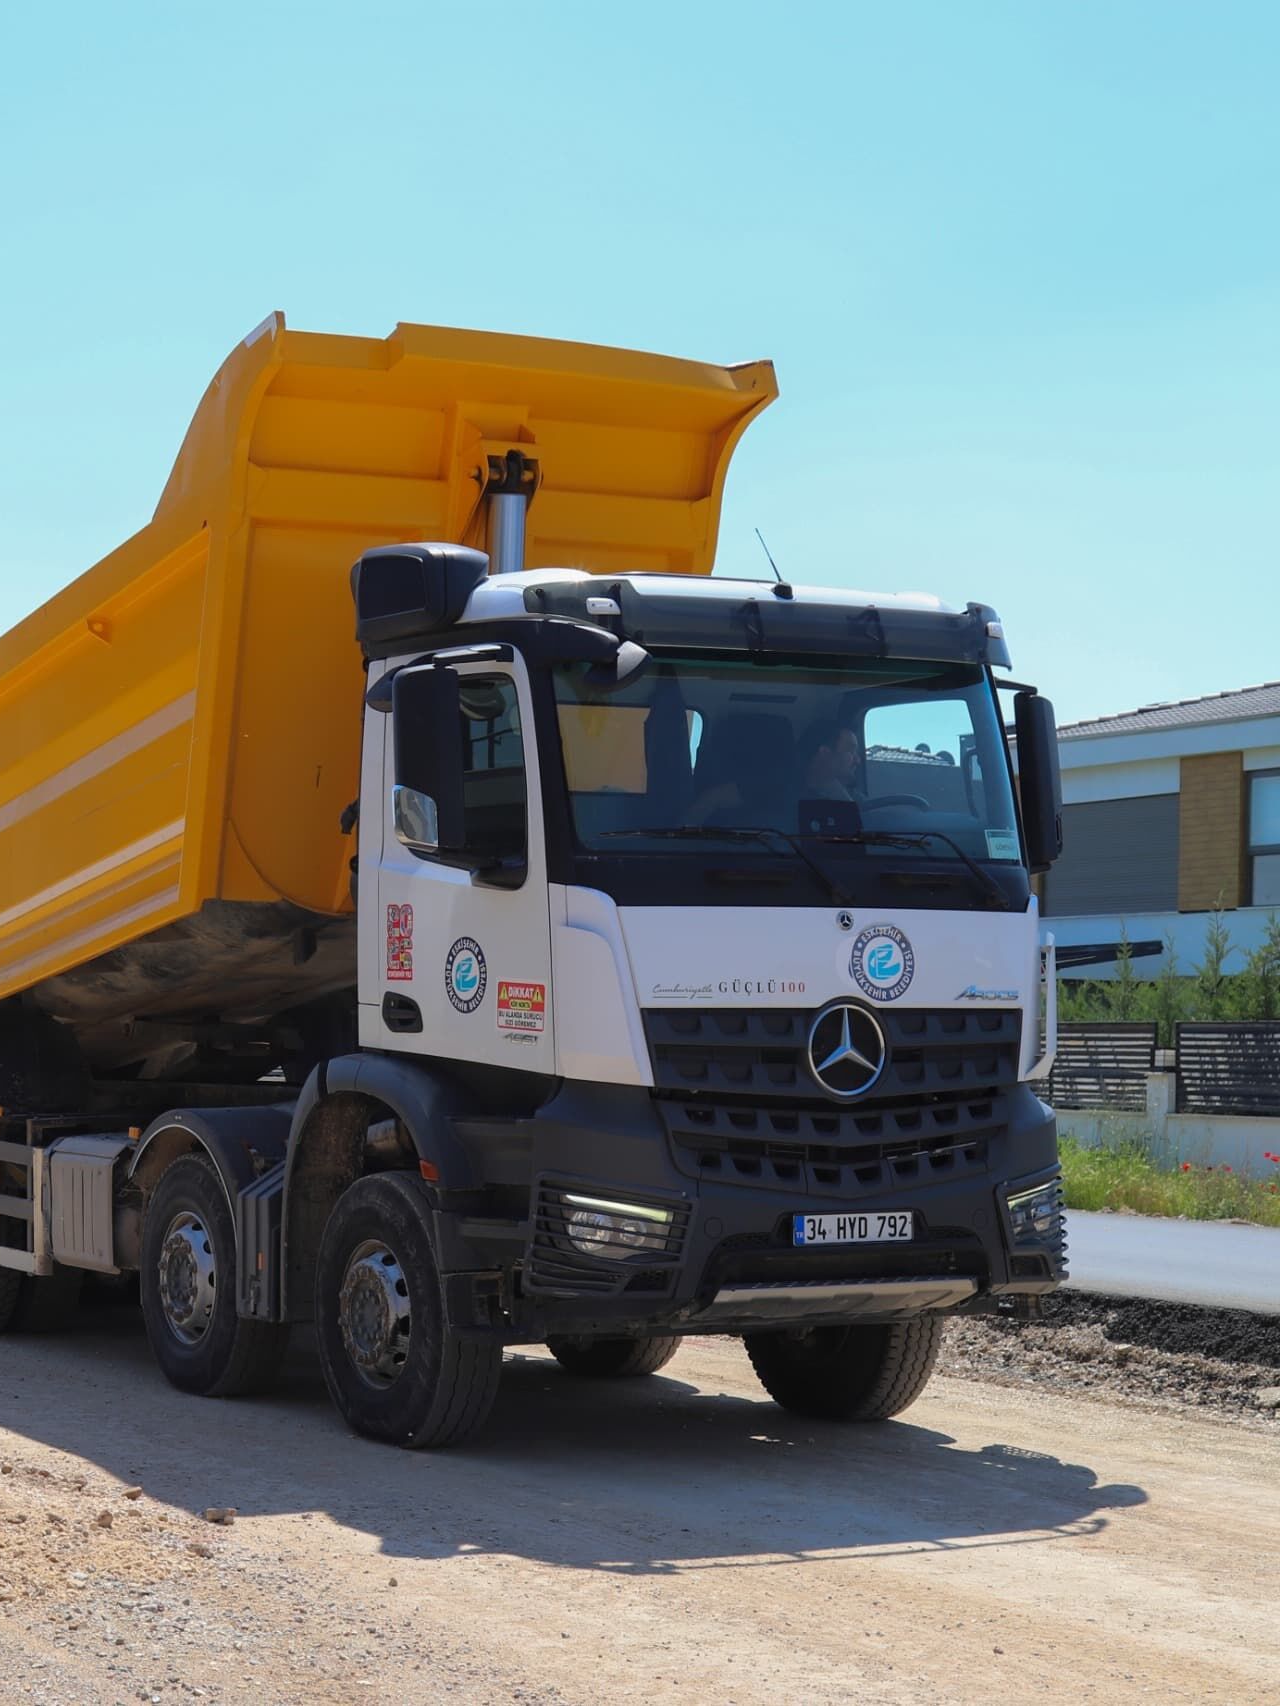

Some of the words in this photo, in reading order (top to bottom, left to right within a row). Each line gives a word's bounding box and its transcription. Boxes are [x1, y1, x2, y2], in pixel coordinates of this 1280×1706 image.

[861, 926, 903, 943] ESKİŞEHİR
[853, 950, 887, 1000] BÜYÜKŞEHİR
[889, 950, 913, 999] BELEDİYESİ
[807, 1218, 826, 1240] 34
[837, 1216, 868, 1240] HYD
[877, 1215, 908, 1238] 792
